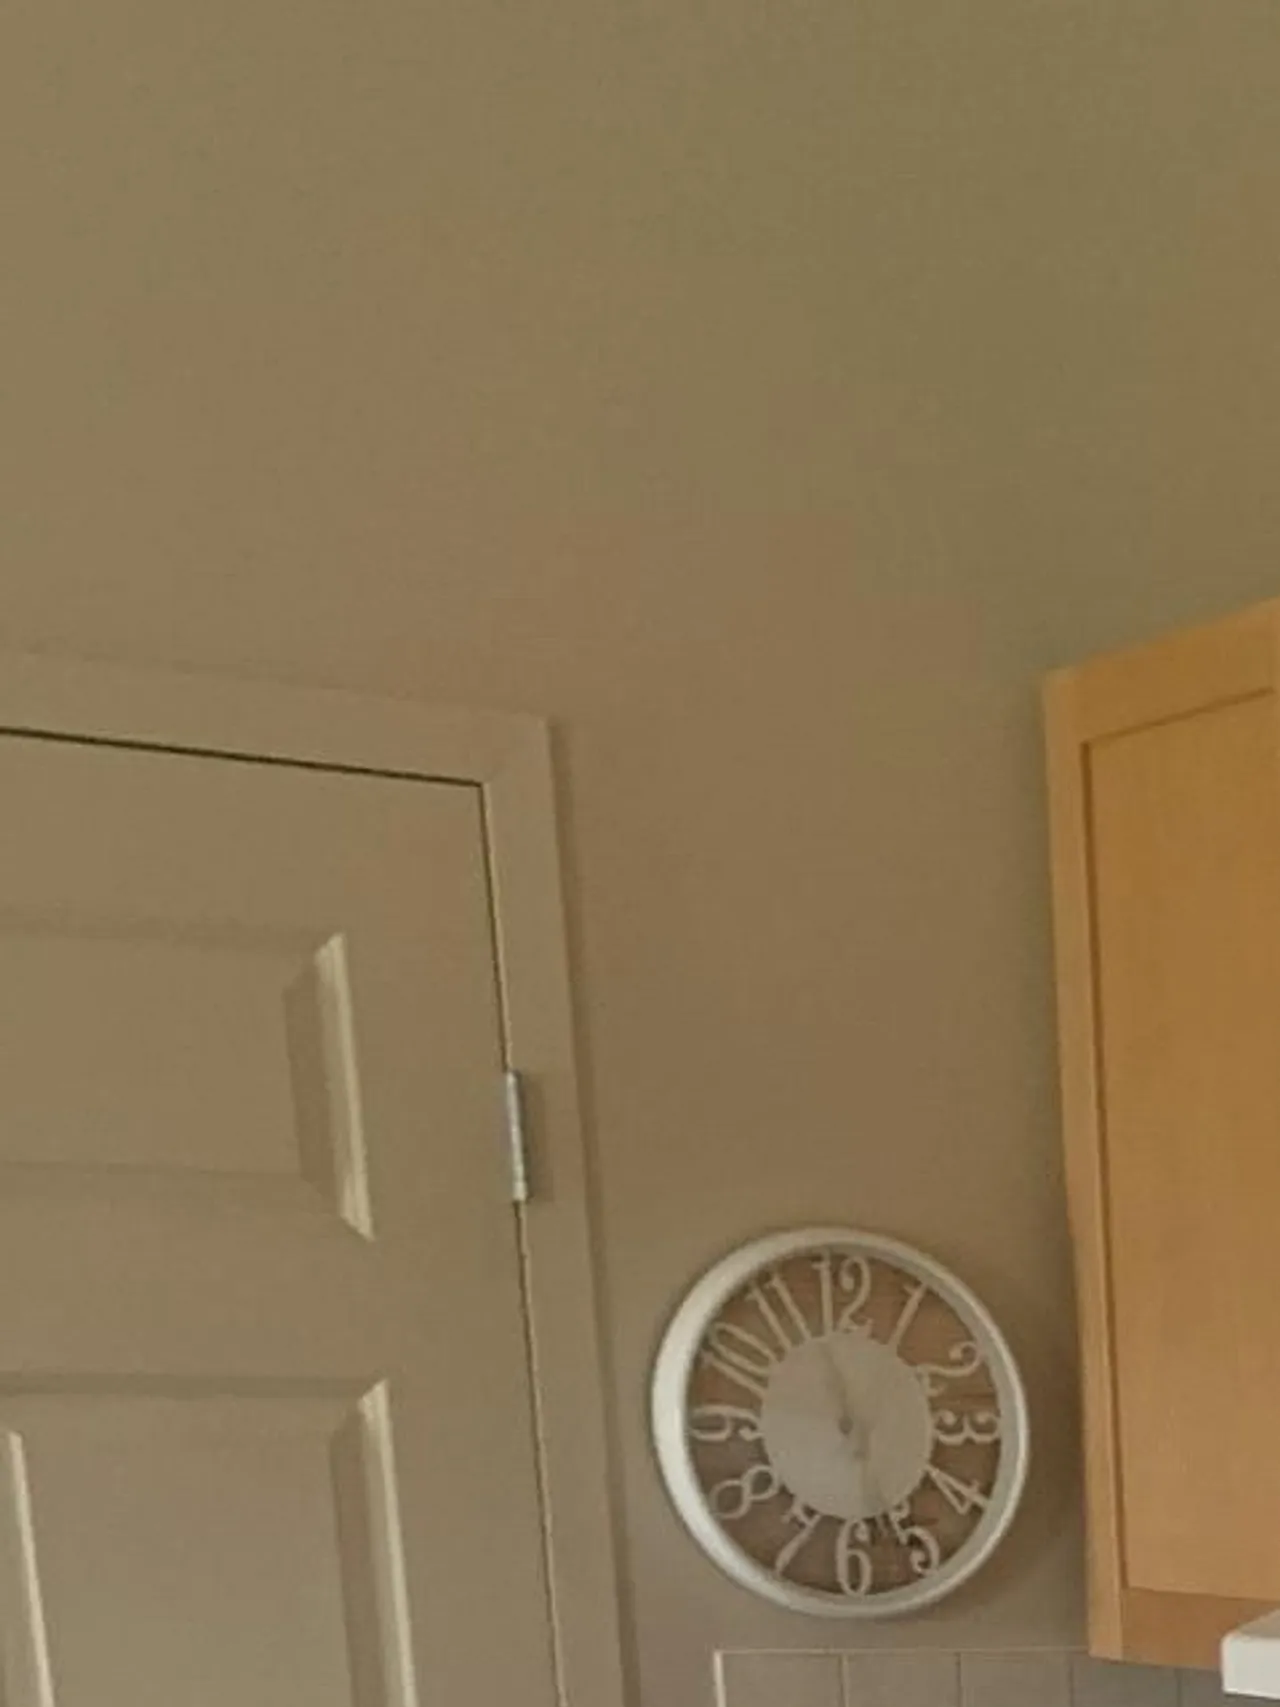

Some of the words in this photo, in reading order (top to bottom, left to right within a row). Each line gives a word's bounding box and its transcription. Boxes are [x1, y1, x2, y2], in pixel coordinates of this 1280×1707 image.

[747, 1274, 812, 1350] 11
[811, 1249, 873, 1338] 12
[889, 1281, 930, 1346] 1
[700, 1320, 779, 1396] 10
[917, 1341, 985, 1396] 2
[688, 1405, 762, 1442] 9
[932, 1410, 999, 1446] 3
[710, 1465, 781, 1520] 8
[925, 1465, 989, 1515] 4
[774, 1503, 822, 1575] 7
[836, 1518, 871, 1599] 6
[889, 1499, 941, 1575] 5
